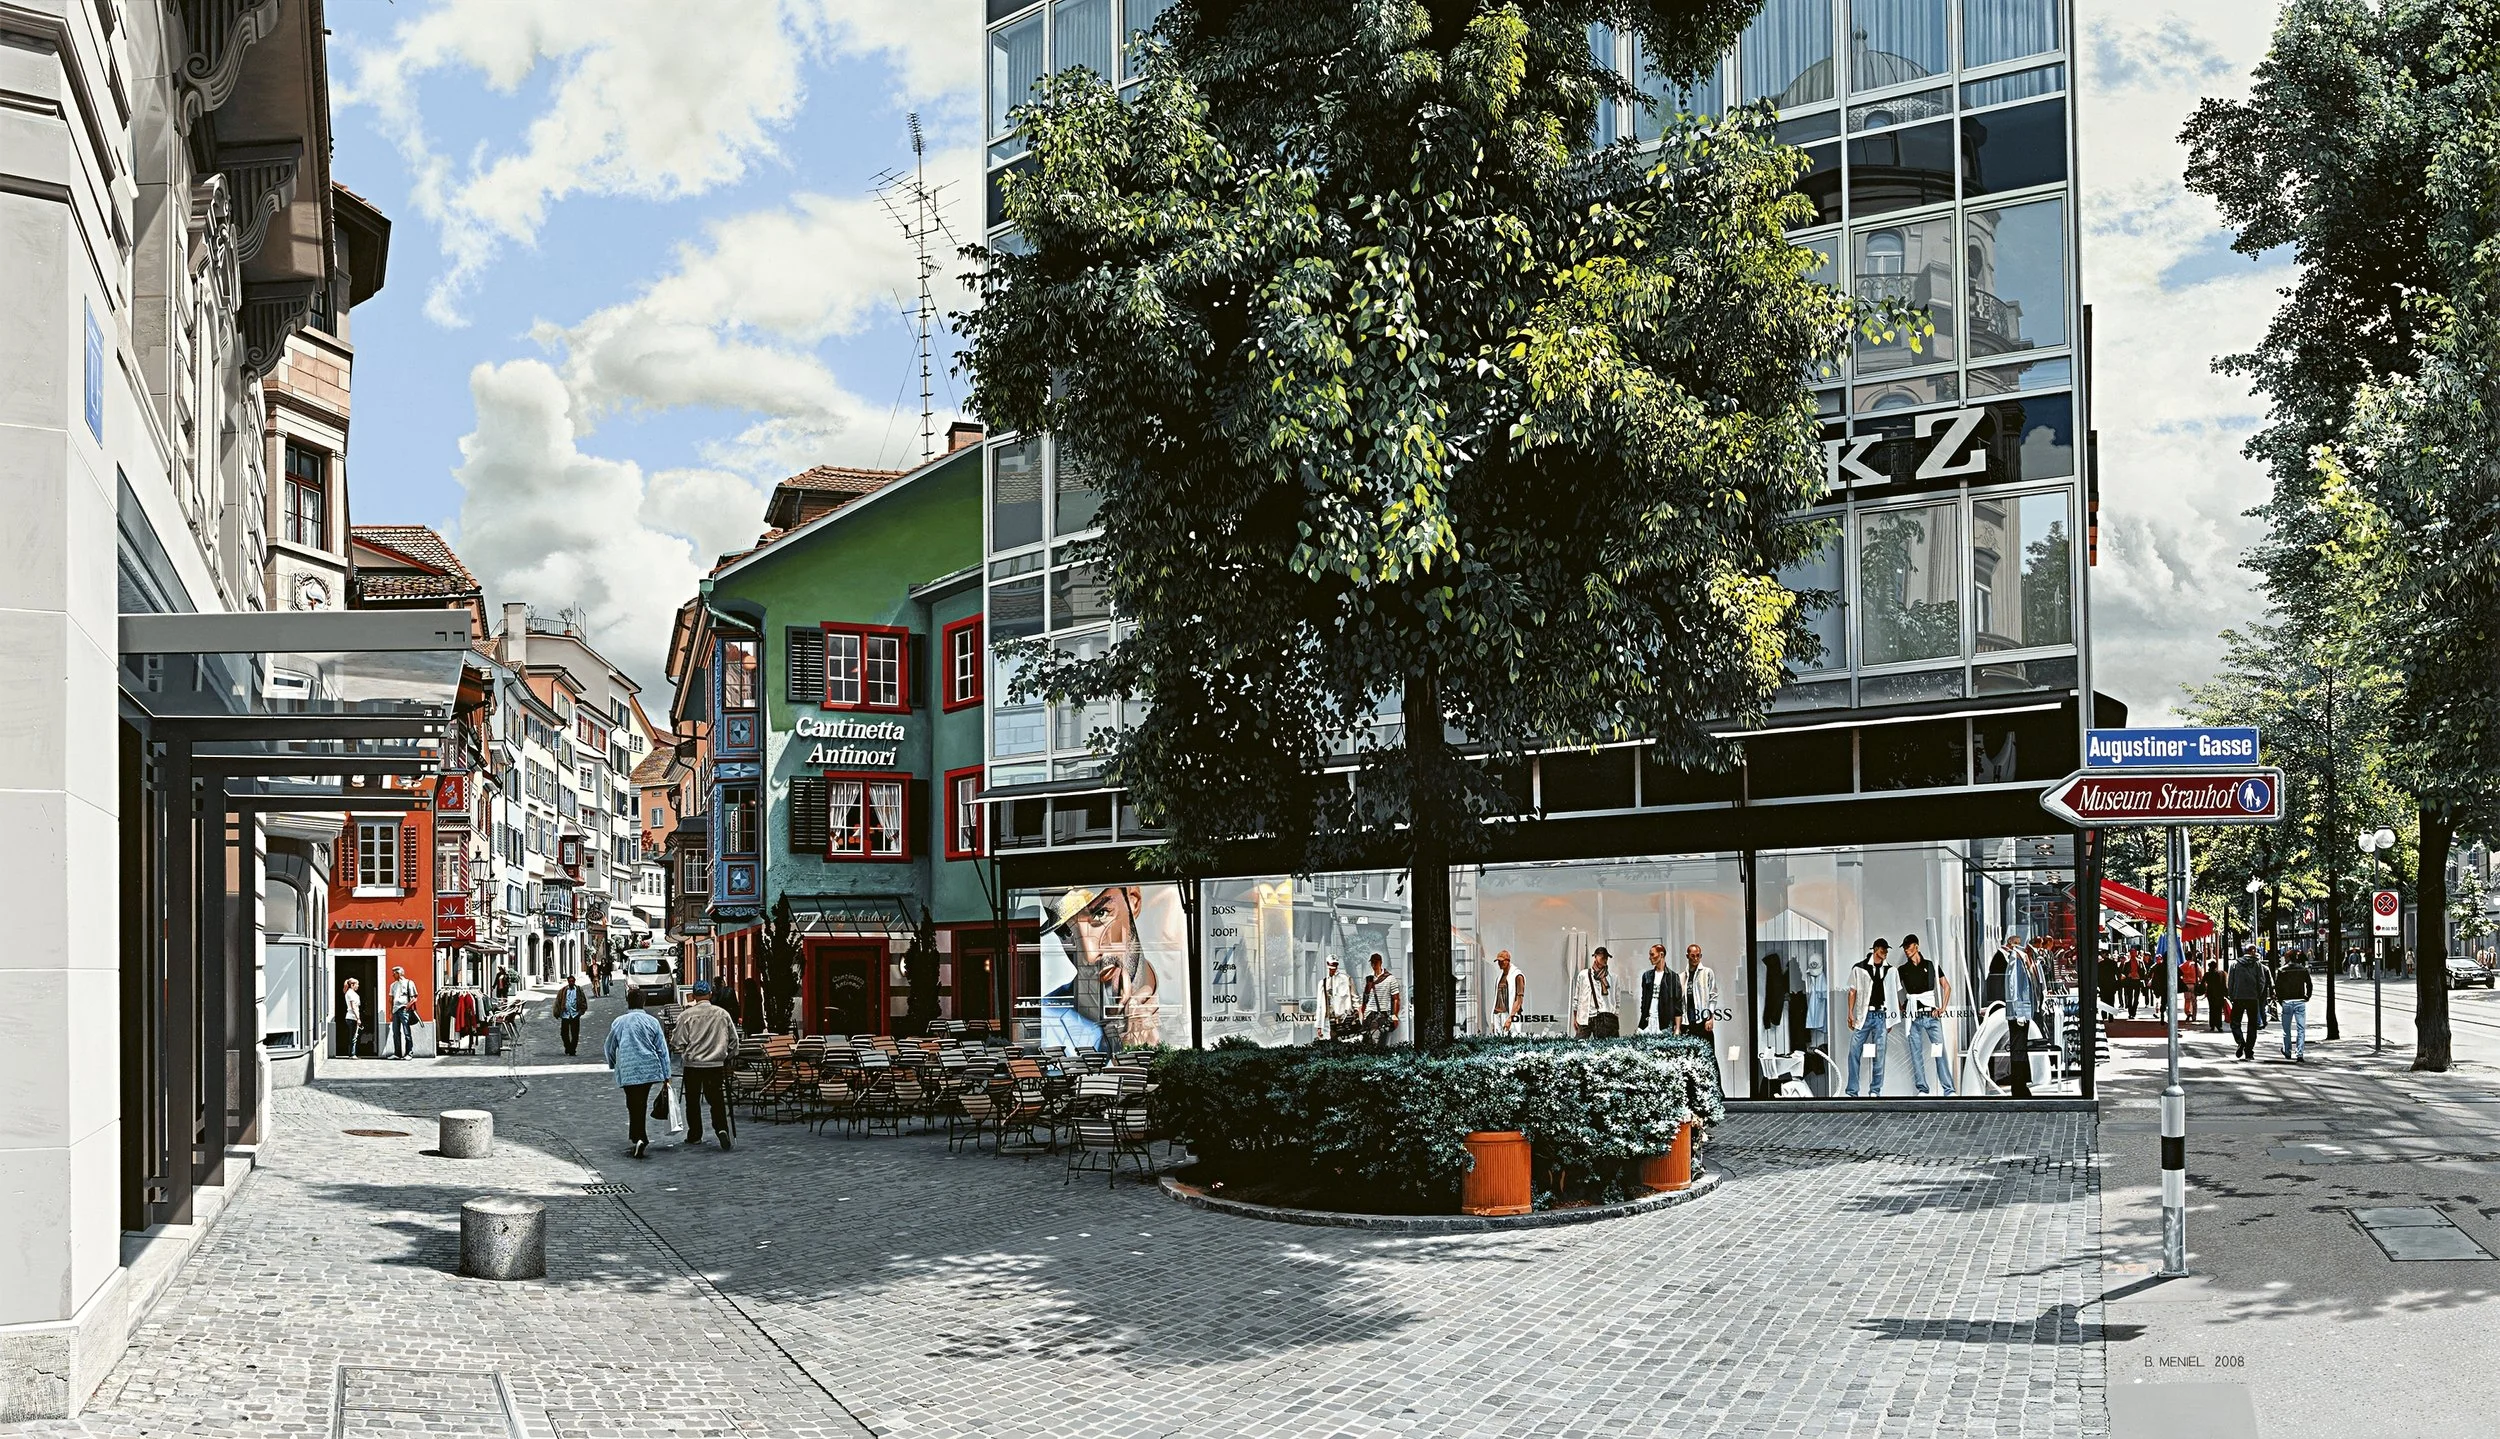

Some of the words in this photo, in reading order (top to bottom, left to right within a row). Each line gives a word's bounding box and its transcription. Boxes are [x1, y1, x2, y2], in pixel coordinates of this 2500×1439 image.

[795, 716, 905, 741] Cantinetta
[804, 742, 897, 766] Antinori
[2089, 734, 2252, 763] Augustiner-Gasse
[2077, 785, 2153, 811] Museum
[2156, 781, 2239, 810] Strauhof
[1211, 905, 1236, 916] BOSS
[334, 919, 375, 930] VERO
[1210, 927, 1238, 937] JOOP!
[1212, 961, 1237, 973] Zegna
[1212, 994, 1238, 1004] HUGO
[1510, 1014, 1558, 1023] DIESEL
[1691, 1008, 1733, 1022] BOSS
[1871, 1011, 1897, 1019] POLO
[1937, 1009, 1975, 1019] LAUREN
